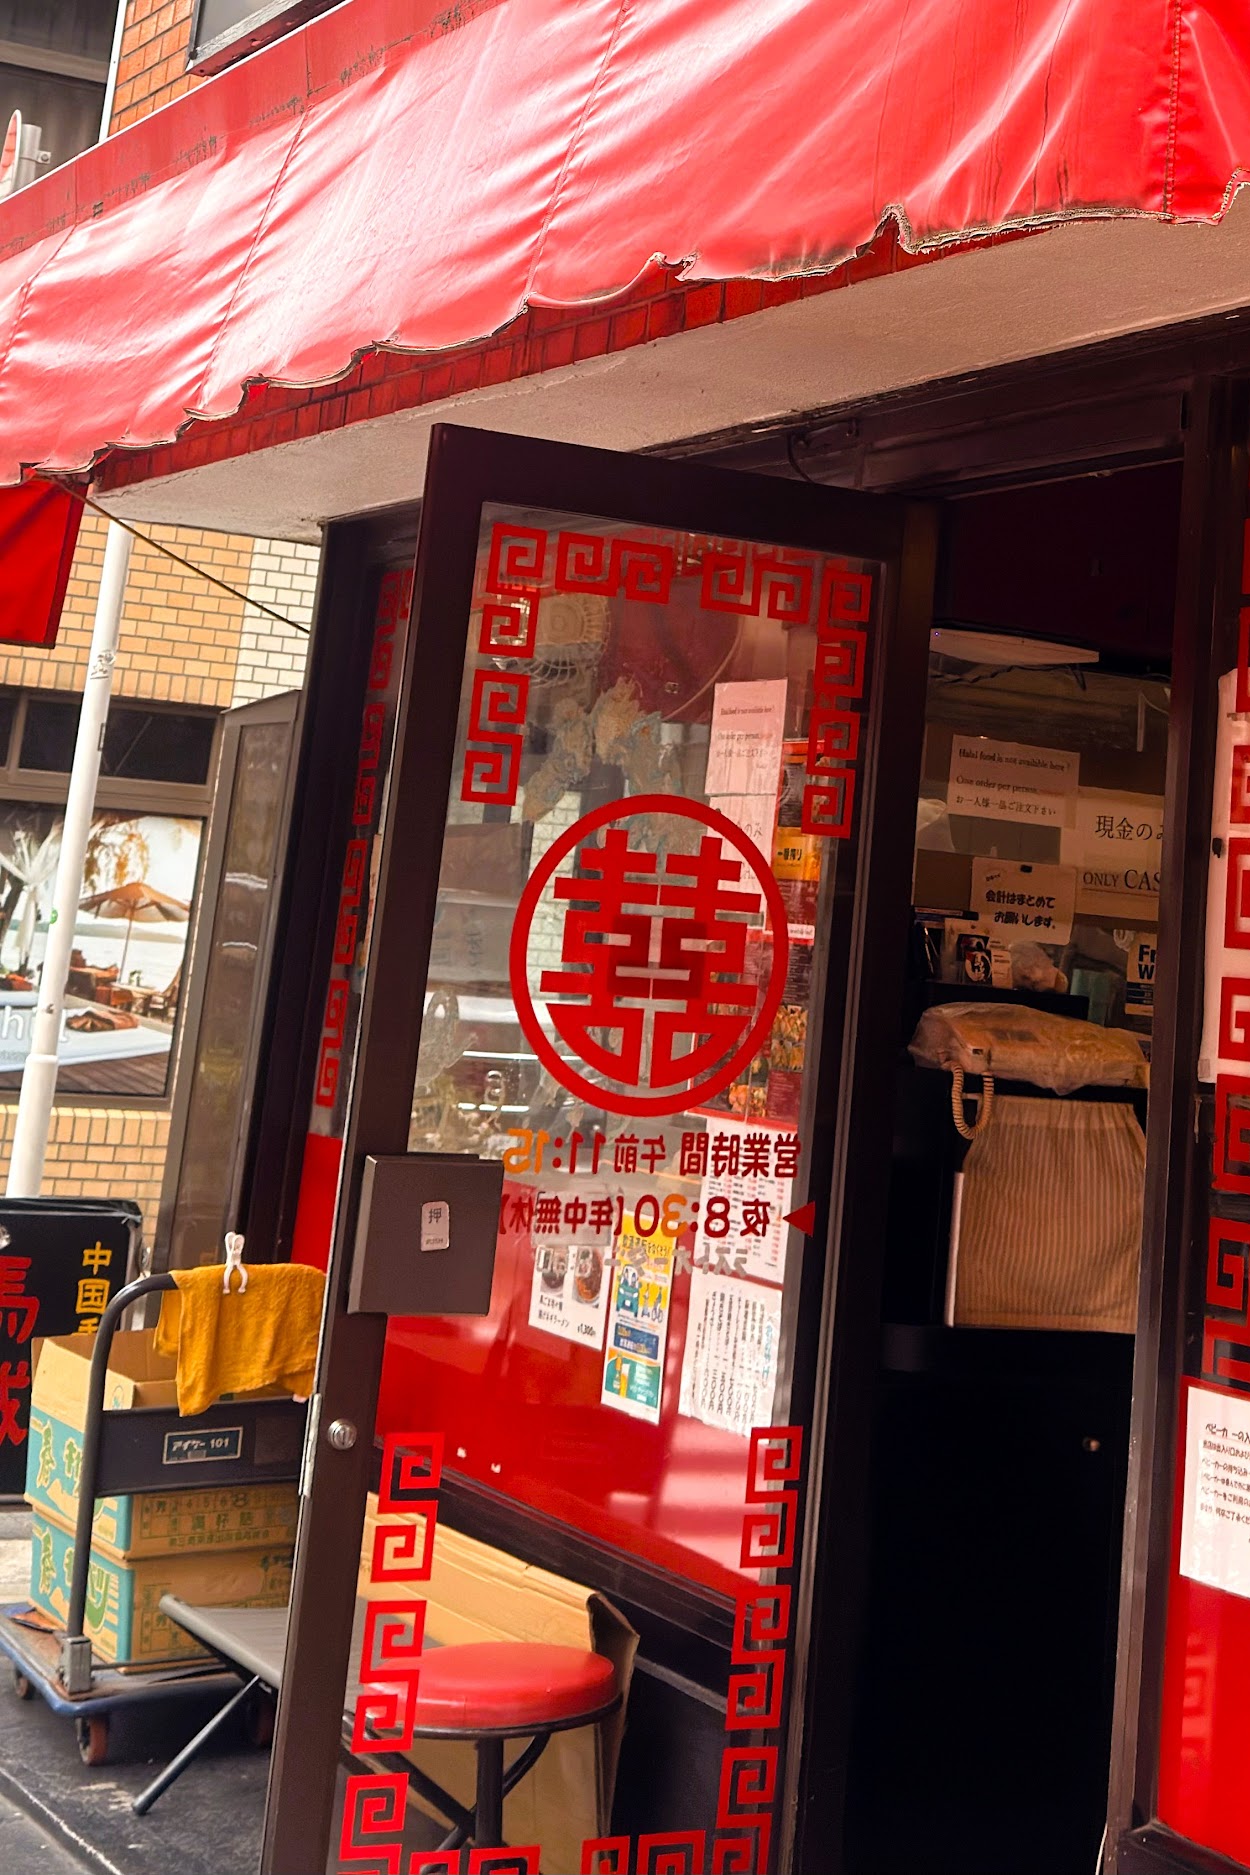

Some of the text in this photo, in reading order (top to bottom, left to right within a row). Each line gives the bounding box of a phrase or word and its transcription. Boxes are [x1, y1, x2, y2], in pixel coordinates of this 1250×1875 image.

[975, 776, 996, 789] order
[1083, 871, 1119, 888] ONLY
[985, 889, 1056, 909] 会計はまとめて
[428, 1207, 442, 1224] 押
[209, 1437, 229, 1449] 101
